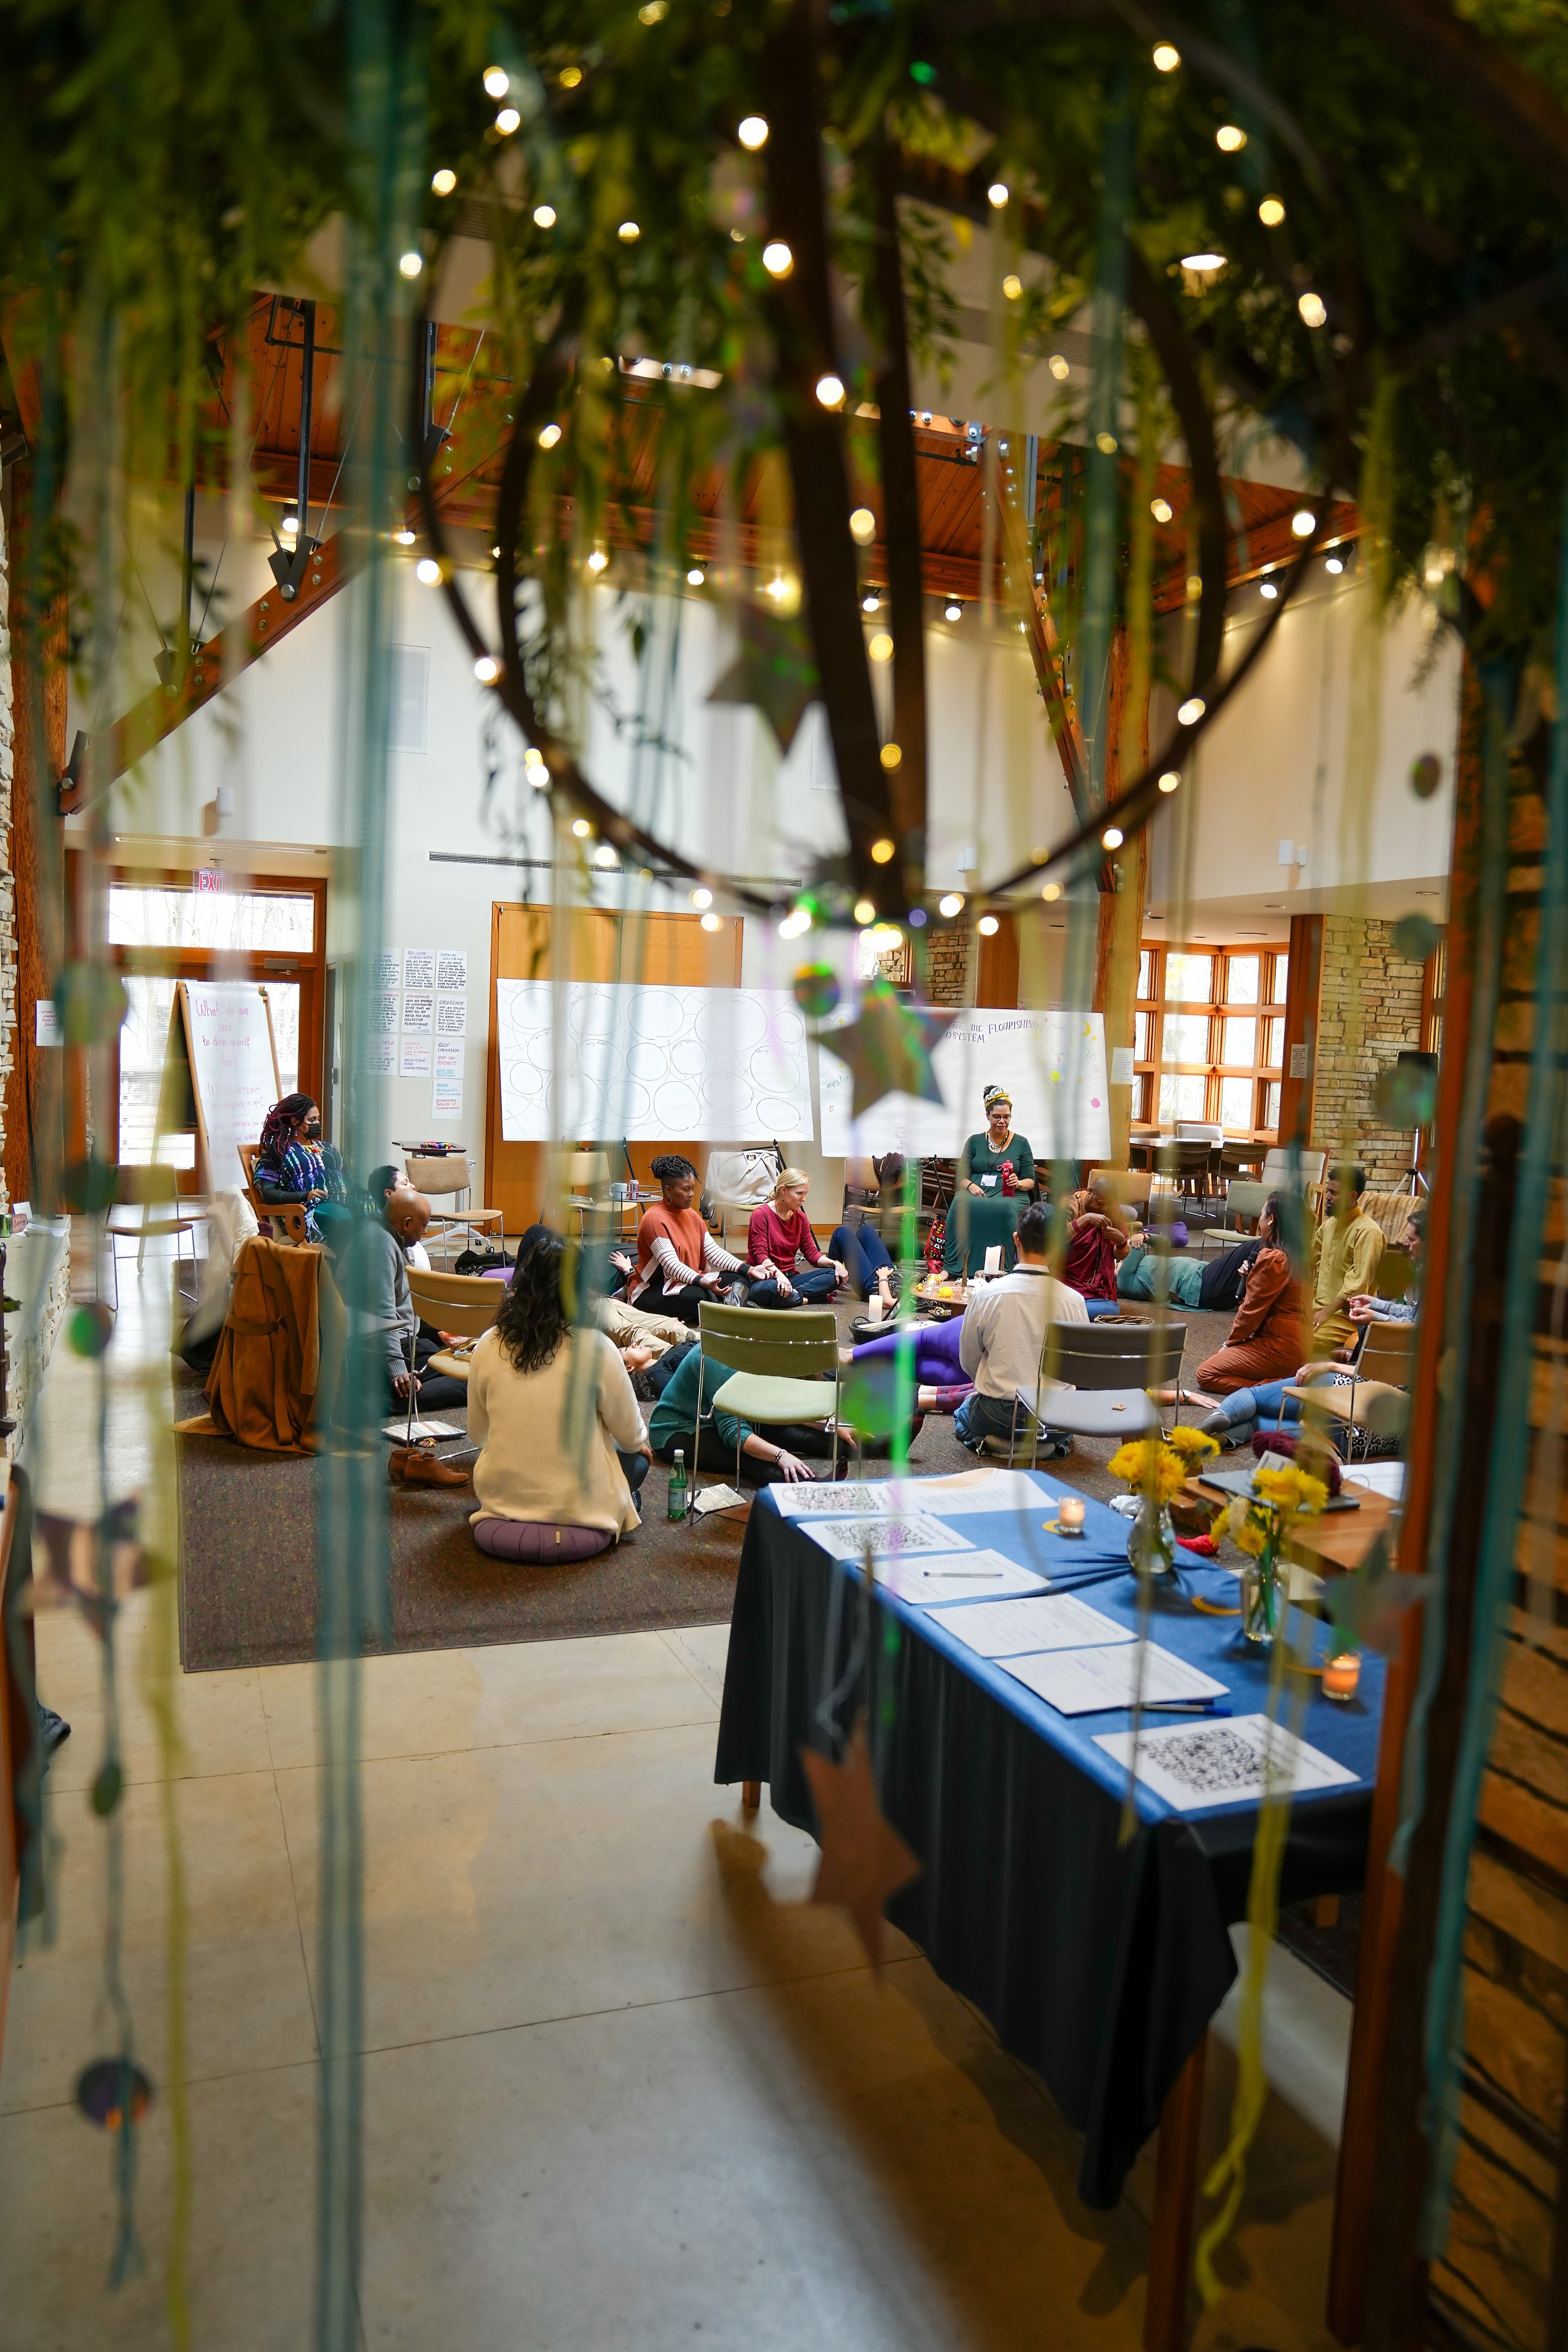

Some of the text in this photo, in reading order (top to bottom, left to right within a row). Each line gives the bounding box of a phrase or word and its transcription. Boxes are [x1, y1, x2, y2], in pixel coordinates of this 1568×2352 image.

[199, 872, 225, 892] EXIT
[194, 999, 249, 1023] What do you
[218, 1022, 233, 1032] need
[970, 1024, 983, 1032] THE
[988, 1019, 1039, 1034] FLOURISHING
[202, 1035, 209, 1046] to
[230, 1036, 250, 1052] yourself
[826, 1075, 853, 1089] mystery
[207, 1083, 230, 1097] What
[253, 1096, 264, 1109] you?
[245, 1133, 258, 1141] want
